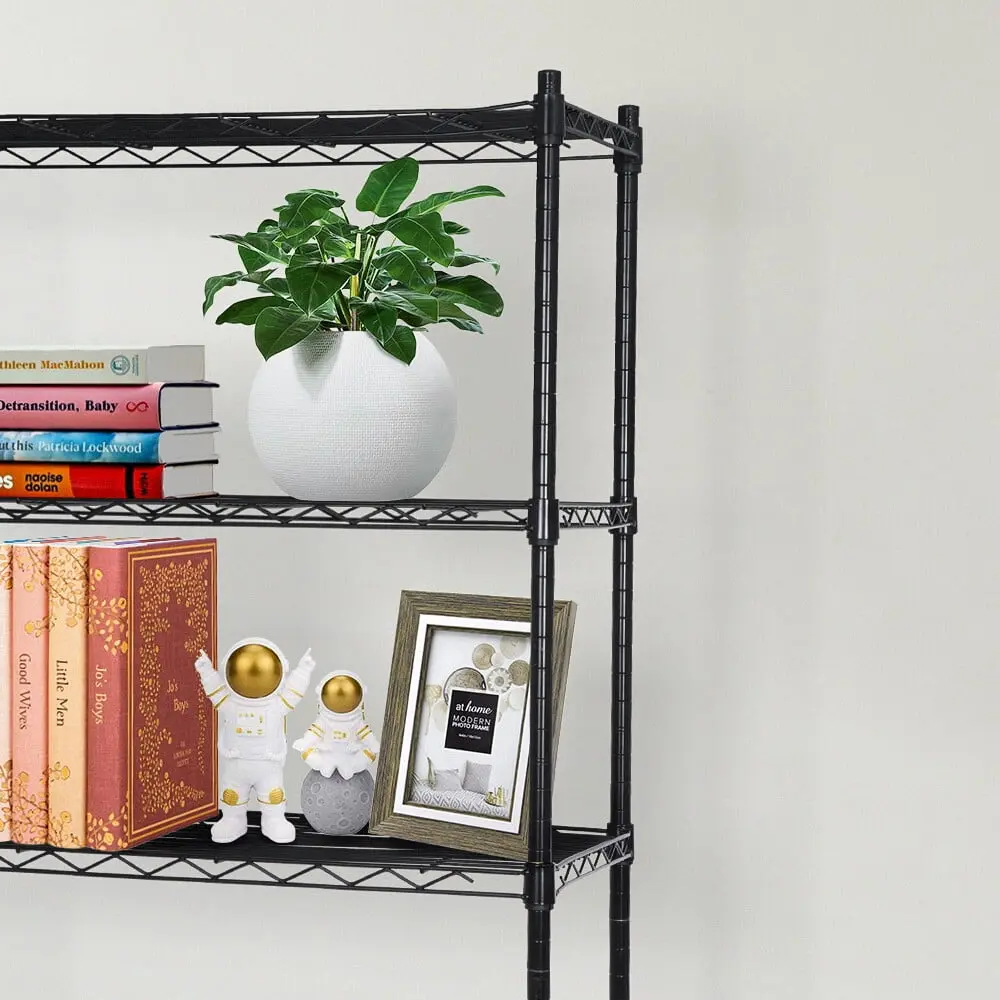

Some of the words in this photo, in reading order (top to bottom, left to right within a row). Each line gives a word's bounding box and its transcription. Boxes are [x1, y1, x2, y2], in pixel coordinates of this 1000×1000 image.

[40, 359, 105, 370] MacMahon
[85, 399, 118, 414] Baby
[11, 440, 34, 451] this
[38, 440, 80, 452] Patricia
[82, 442, 142, 454] Lockwood
[25, 472, 63, 483] naoise
[25, 482, 58, 492] dolan
[18, 653, 32, 685] Good
[56, 660, 70, 692] Little
[95, 664, 107, 688] Jo's
[19, 690, 32, 730] Wives
[56, 698, 69, 727] Men
[92, 693, 107, 725] Boys
[455, 703, 464, 711] at
[465, 700, 493, 714] home
[452, 721, 471, 729] PHOTO
[453, 715, 491, 726] MODERN
